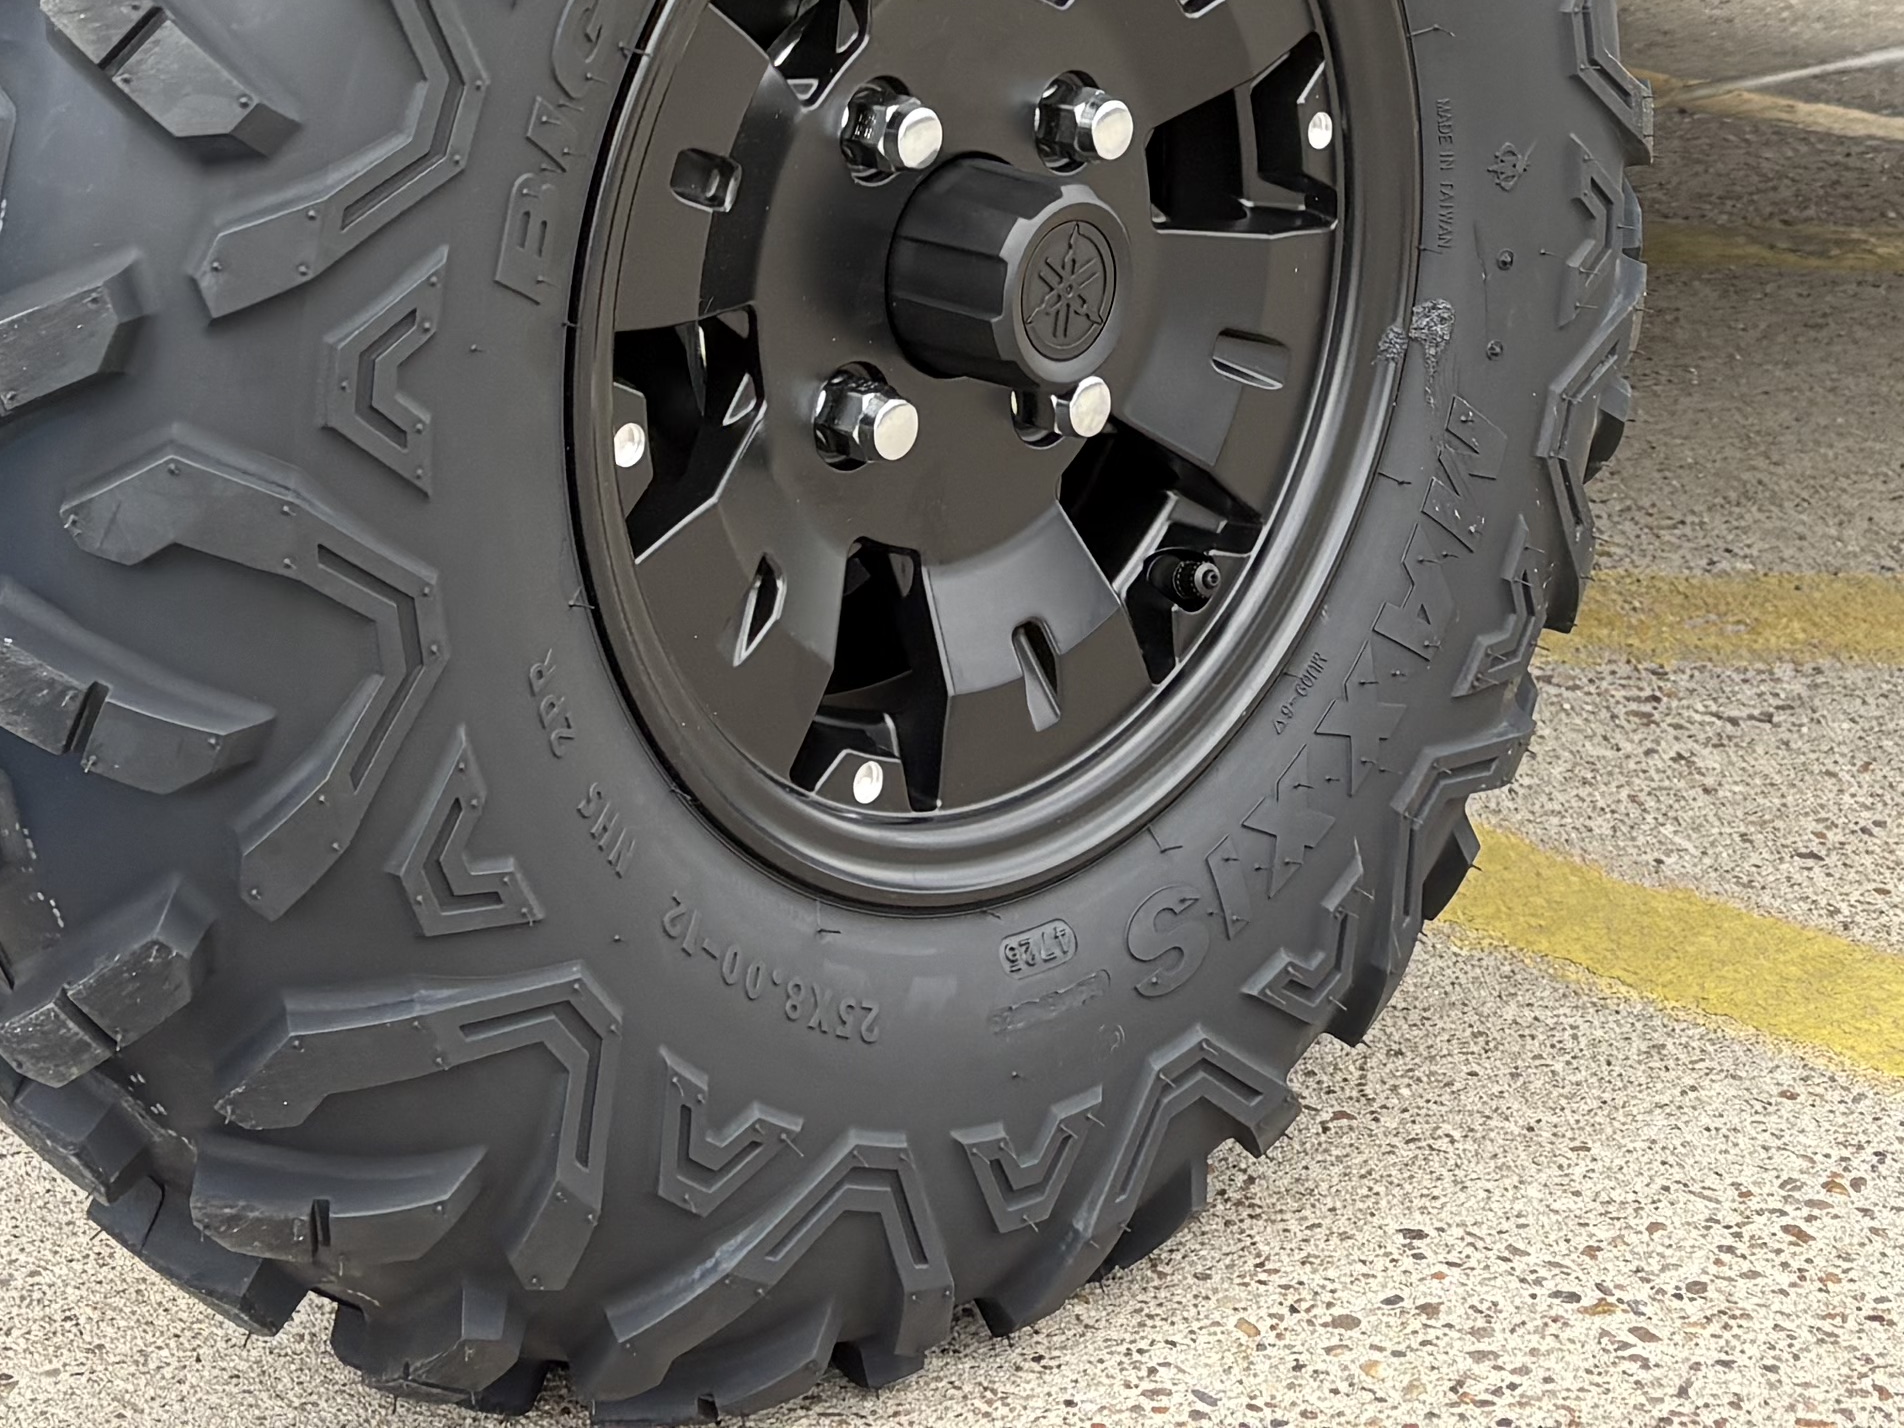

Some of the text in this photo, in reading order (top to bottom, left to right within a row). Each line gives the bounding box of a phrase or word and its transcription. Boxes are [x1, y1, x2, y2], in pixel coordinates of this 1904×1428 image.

[1436, 96, 1454, 249] MADE IN TAIWAN
[1125, 393, 1507, 1002] MAXXIS
[575, 780, 636, 880] NHS
